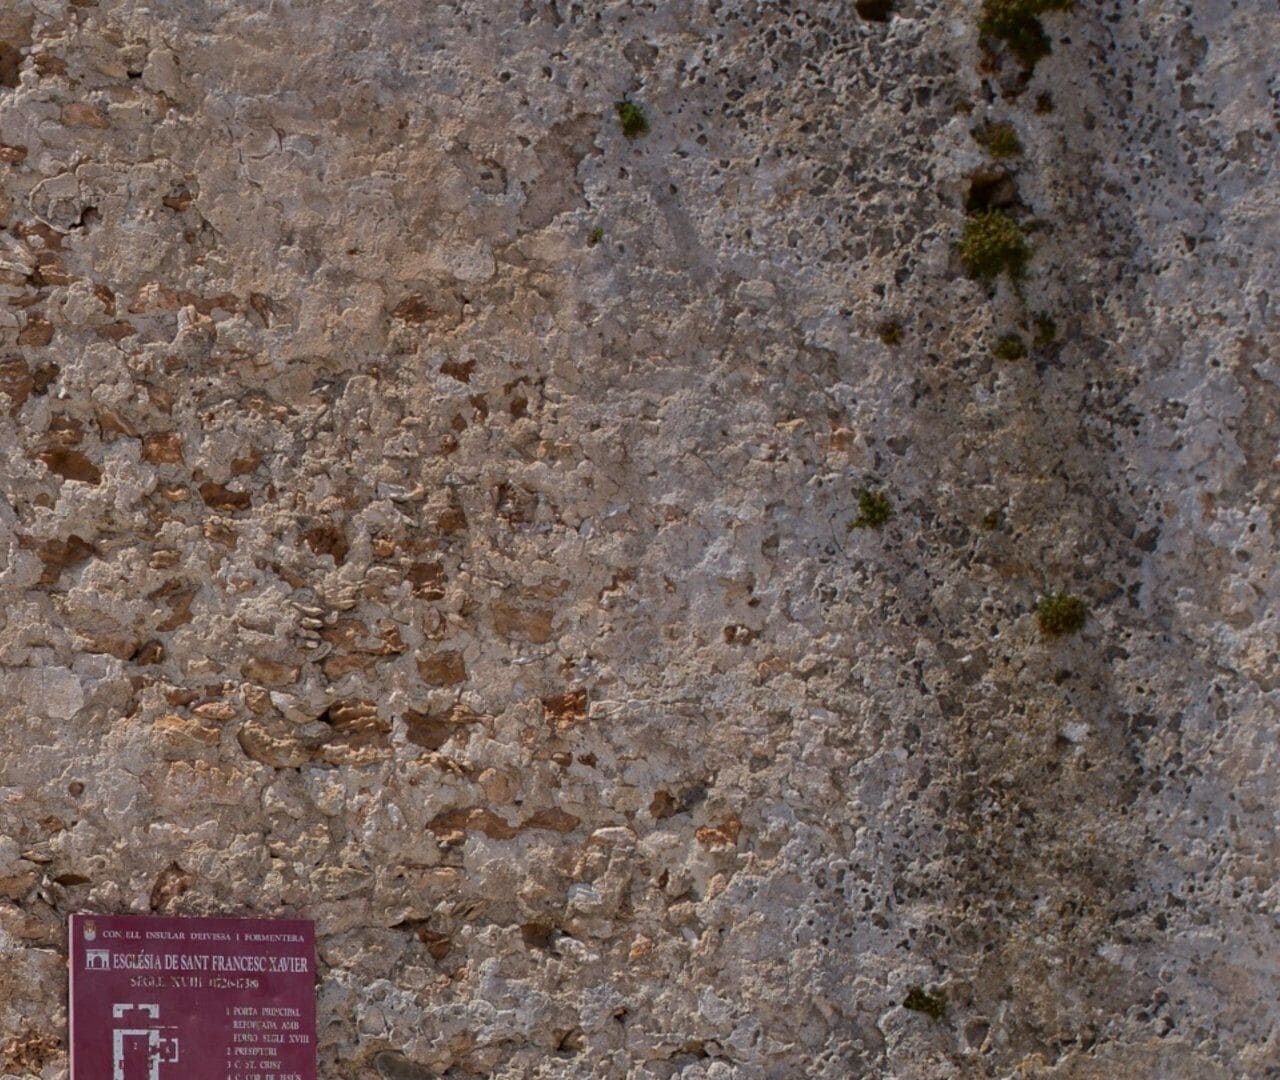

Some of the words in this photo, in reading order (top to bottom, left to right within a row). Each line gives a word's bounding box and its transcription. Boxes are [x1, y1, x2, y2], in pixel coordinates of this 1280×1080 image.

[145, 931, 185, 940] INSULAR
[236, 933, 240, 941] I
[244, 933, 305, 943] FORMENTERA
[113, 949, 162, 970] ESGLÉSIA
[165, 954, 179, 970] DE
[180, 955, 209, 970] SANT
[212, 955, 267, 972] FRANCESC
[269, 956, 308, 973] XAVIER
[226, 1007, 230, 1016] 1
[233, 1007, 258, 1016] PORTA
[261, 1007, 301, 1017] PRINCIPAL
[281, 1021, 300, 1030] AMB
[289, 1034, 310, 1043] XVIII
[226, 1047, 231, 1056] 2
